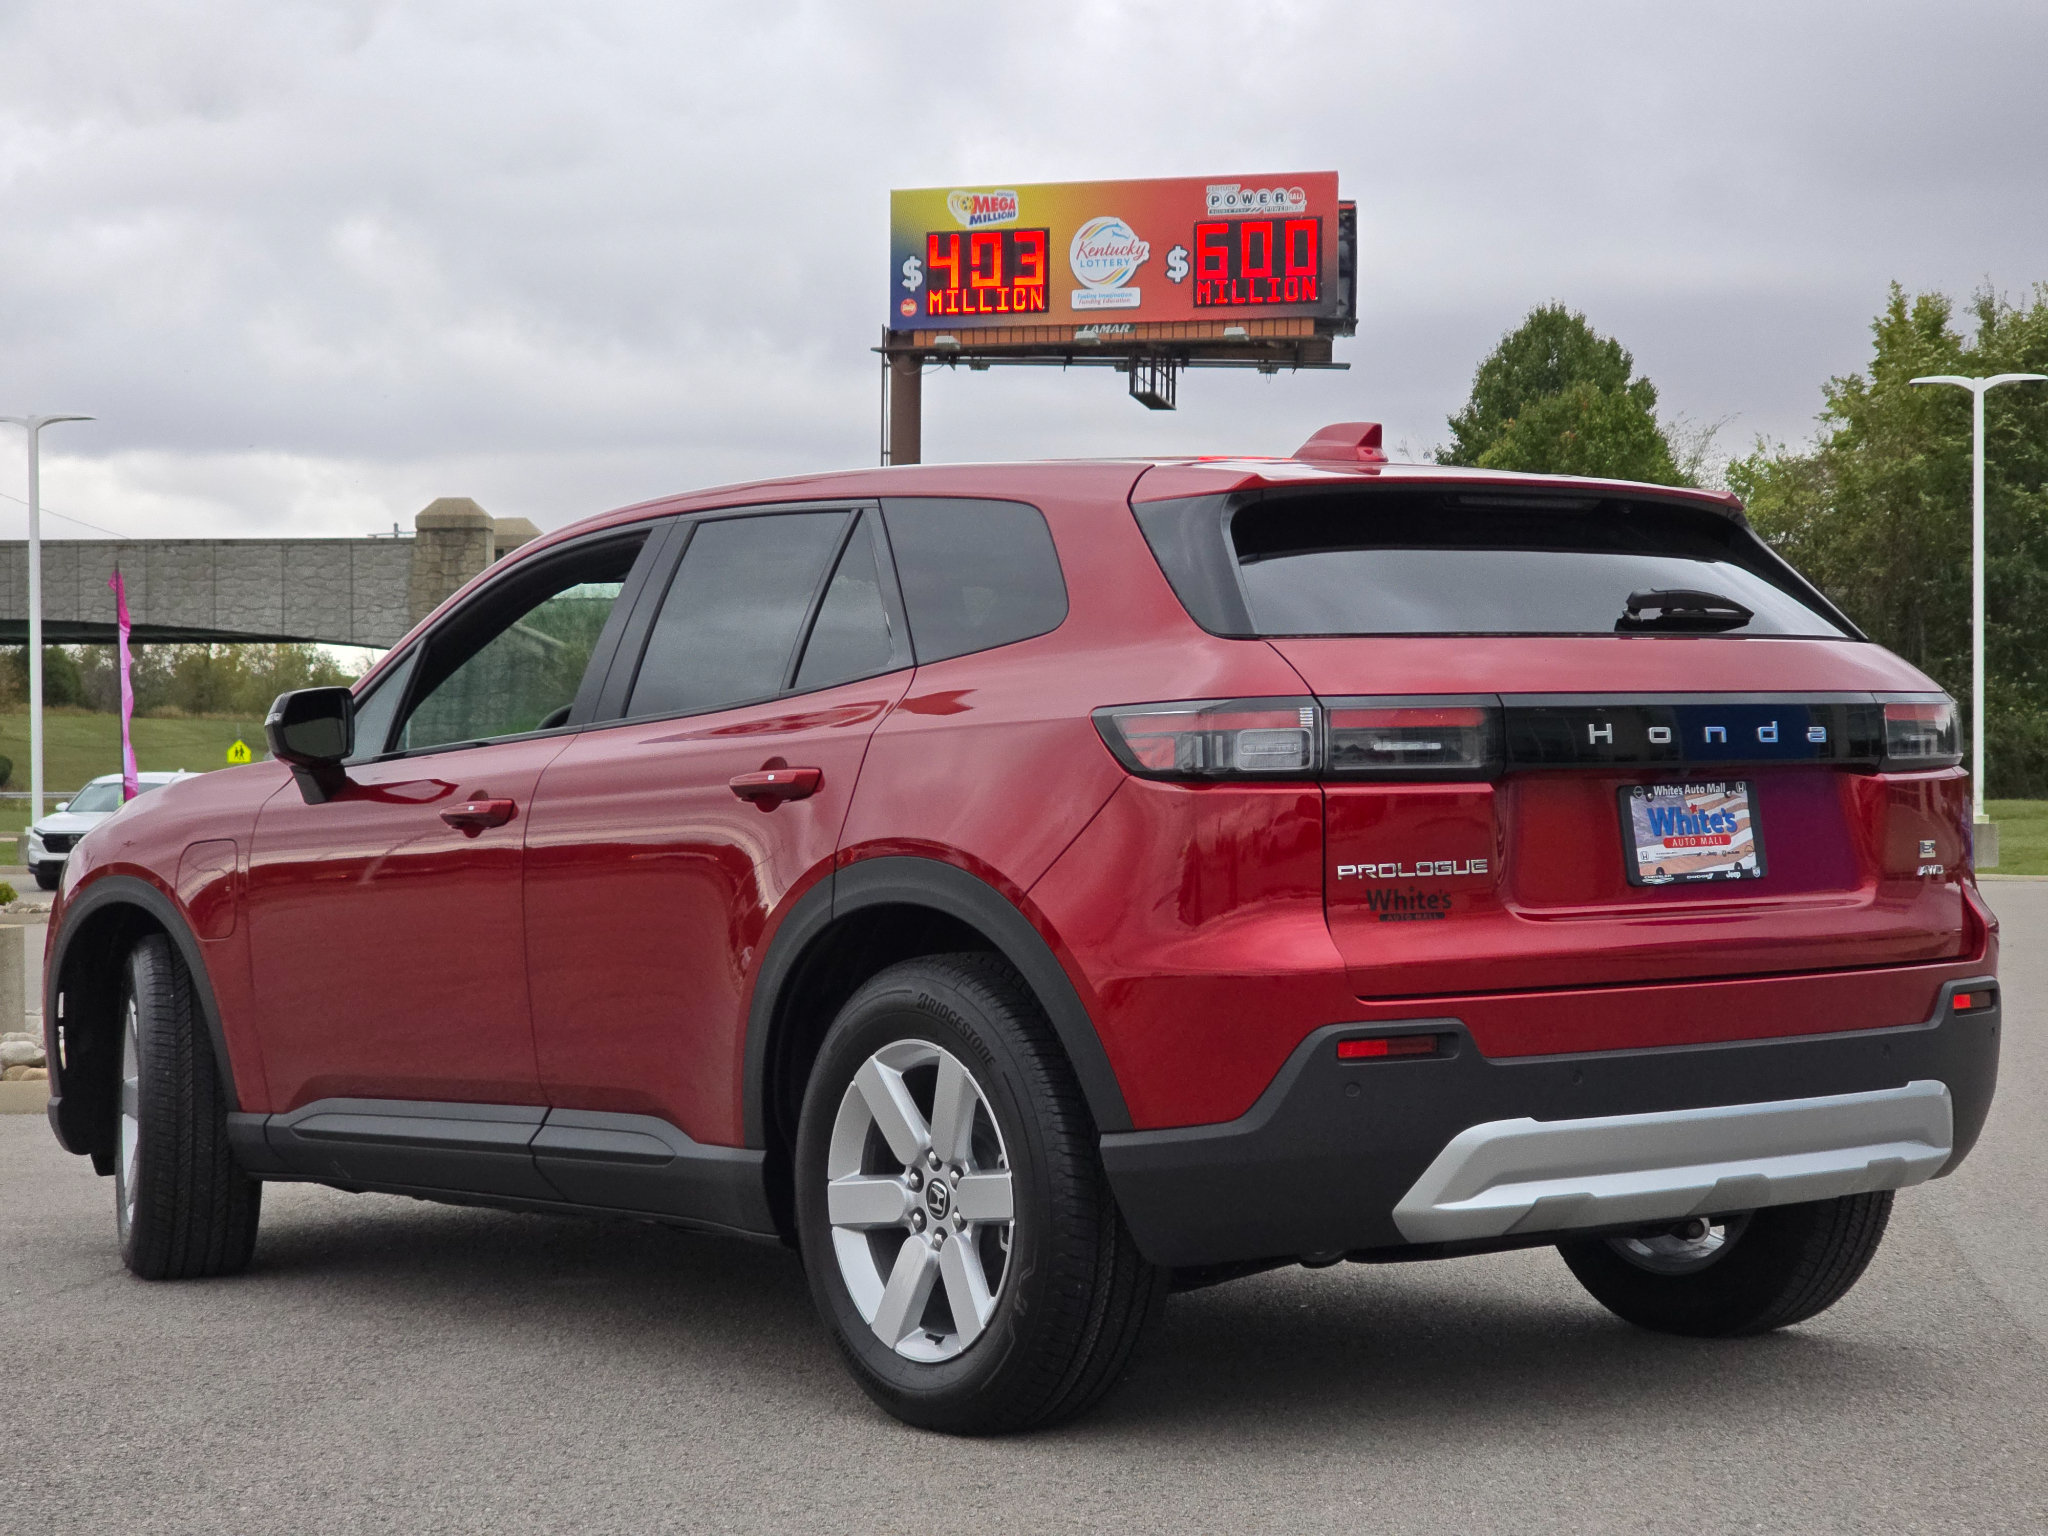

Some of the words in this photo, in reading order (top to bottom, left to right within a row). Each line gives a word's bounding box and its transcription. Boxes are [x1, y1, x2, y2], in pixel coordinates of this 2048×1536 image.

[971, 195, 1016, 215] MEGA
[969, 210, 1016, 226] MILLIONS
[1076, 240, 1146, 260] Kentucky
[1080, 258, 1131, 268] LOTTERY
[929, 286, 1044, 315] MILLION
[1196, 276, 1317, 305] MILLION
[1083, 323, 1131, 334] LAMAR
[1653, 785, 1684, 796] White's
[1684, 783, 1704, 794] Auto
[1706, 782, 1726, 794] Mall
[1646, 804, 1738, 837] White's
[1672, 837, 1696, 847] AUTO
[1700, 835, 1724, 846] MALL
[1337, 858, 1489, 880] PROLOGUE
[1726, 870, 1742, 879] Jeep
[1366, 886, 1453, 912] White's
[917, 992, 996, 1067] BRIDGESTONE
